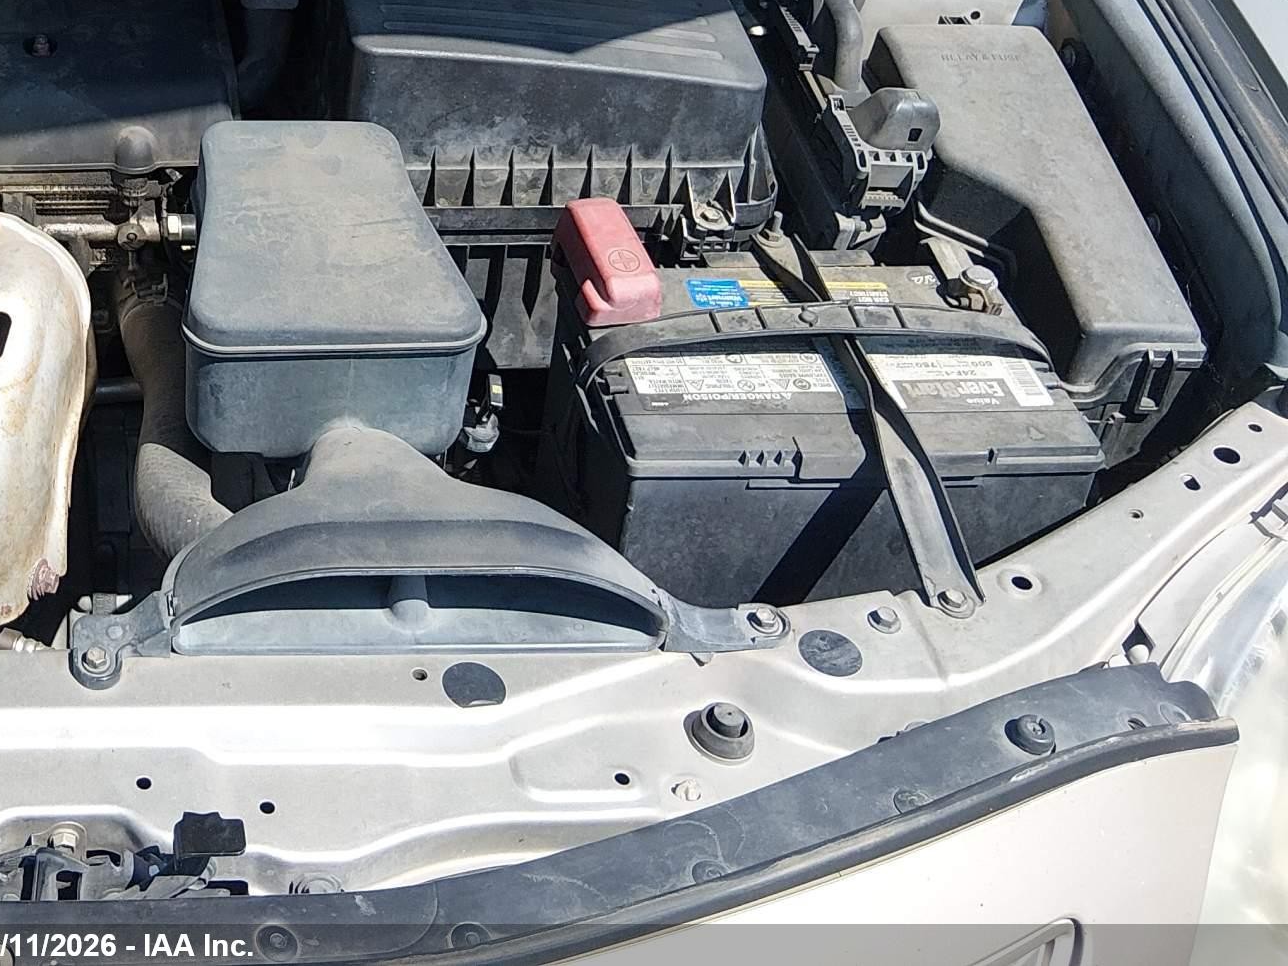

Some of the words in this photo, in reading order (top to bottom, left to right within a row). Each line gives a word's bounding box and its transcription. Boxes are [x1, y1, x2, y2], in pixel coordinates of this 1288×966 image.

[901, 380, 1006, 398] EverStart
[682, 393, 782, 402] DANGER/POISON
[966, 397, 1001, 405] Value
